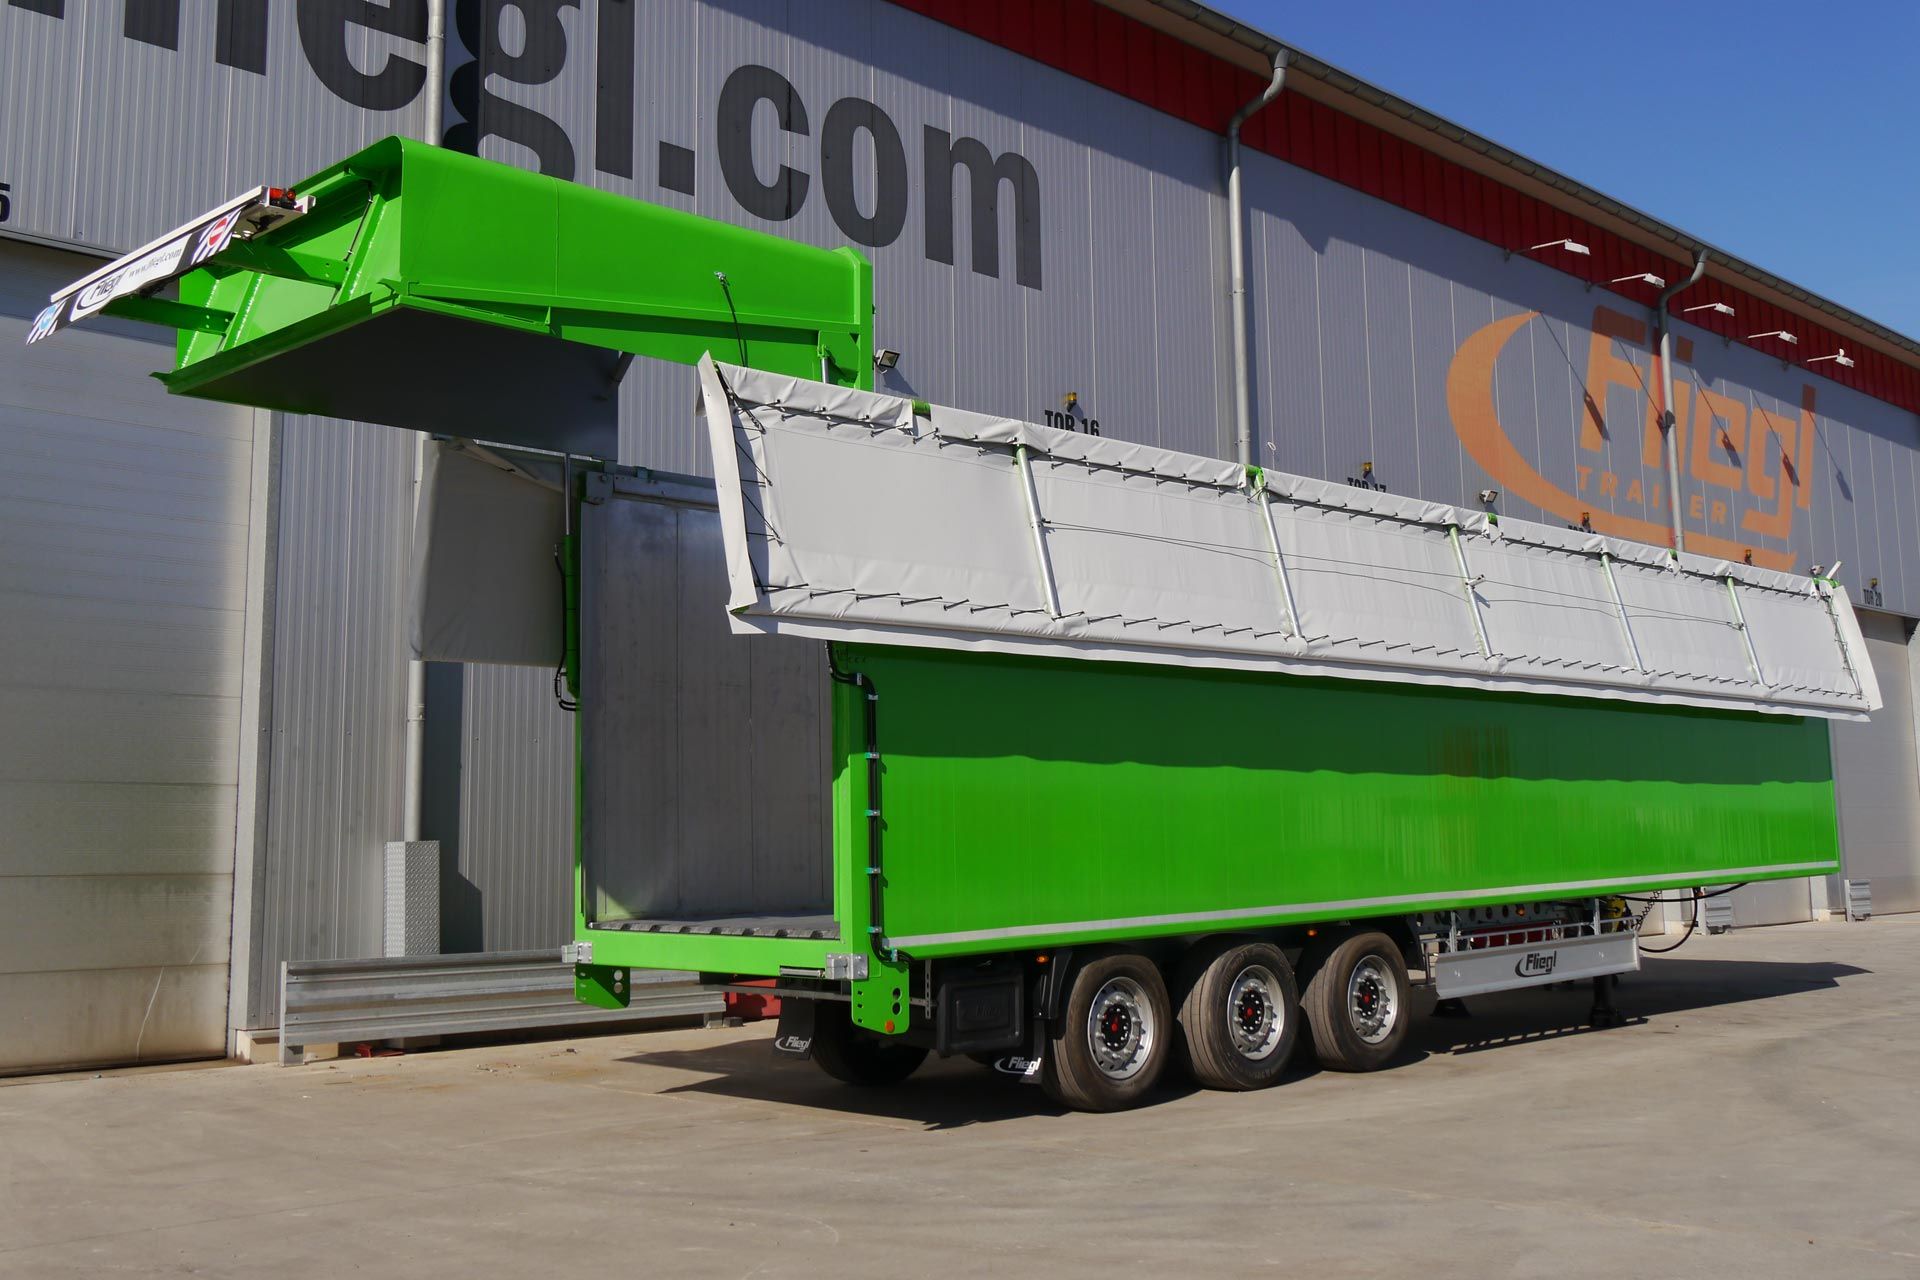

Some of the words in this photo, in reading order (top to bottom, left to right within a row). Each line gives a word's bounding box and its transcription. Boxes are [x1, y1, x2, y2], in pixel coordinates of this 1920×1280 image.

[1081, 418, 1100, 437] 16
[1580, 304, 1816, 540] Fliegl
[1576, 464, 1727, 524] TRAIER
[1525, 950, 1557, 972] Fliegl
[786, 1036, 811, 1050] Fliegl
[1008, 1056, 1041, 1072] Fliegl
